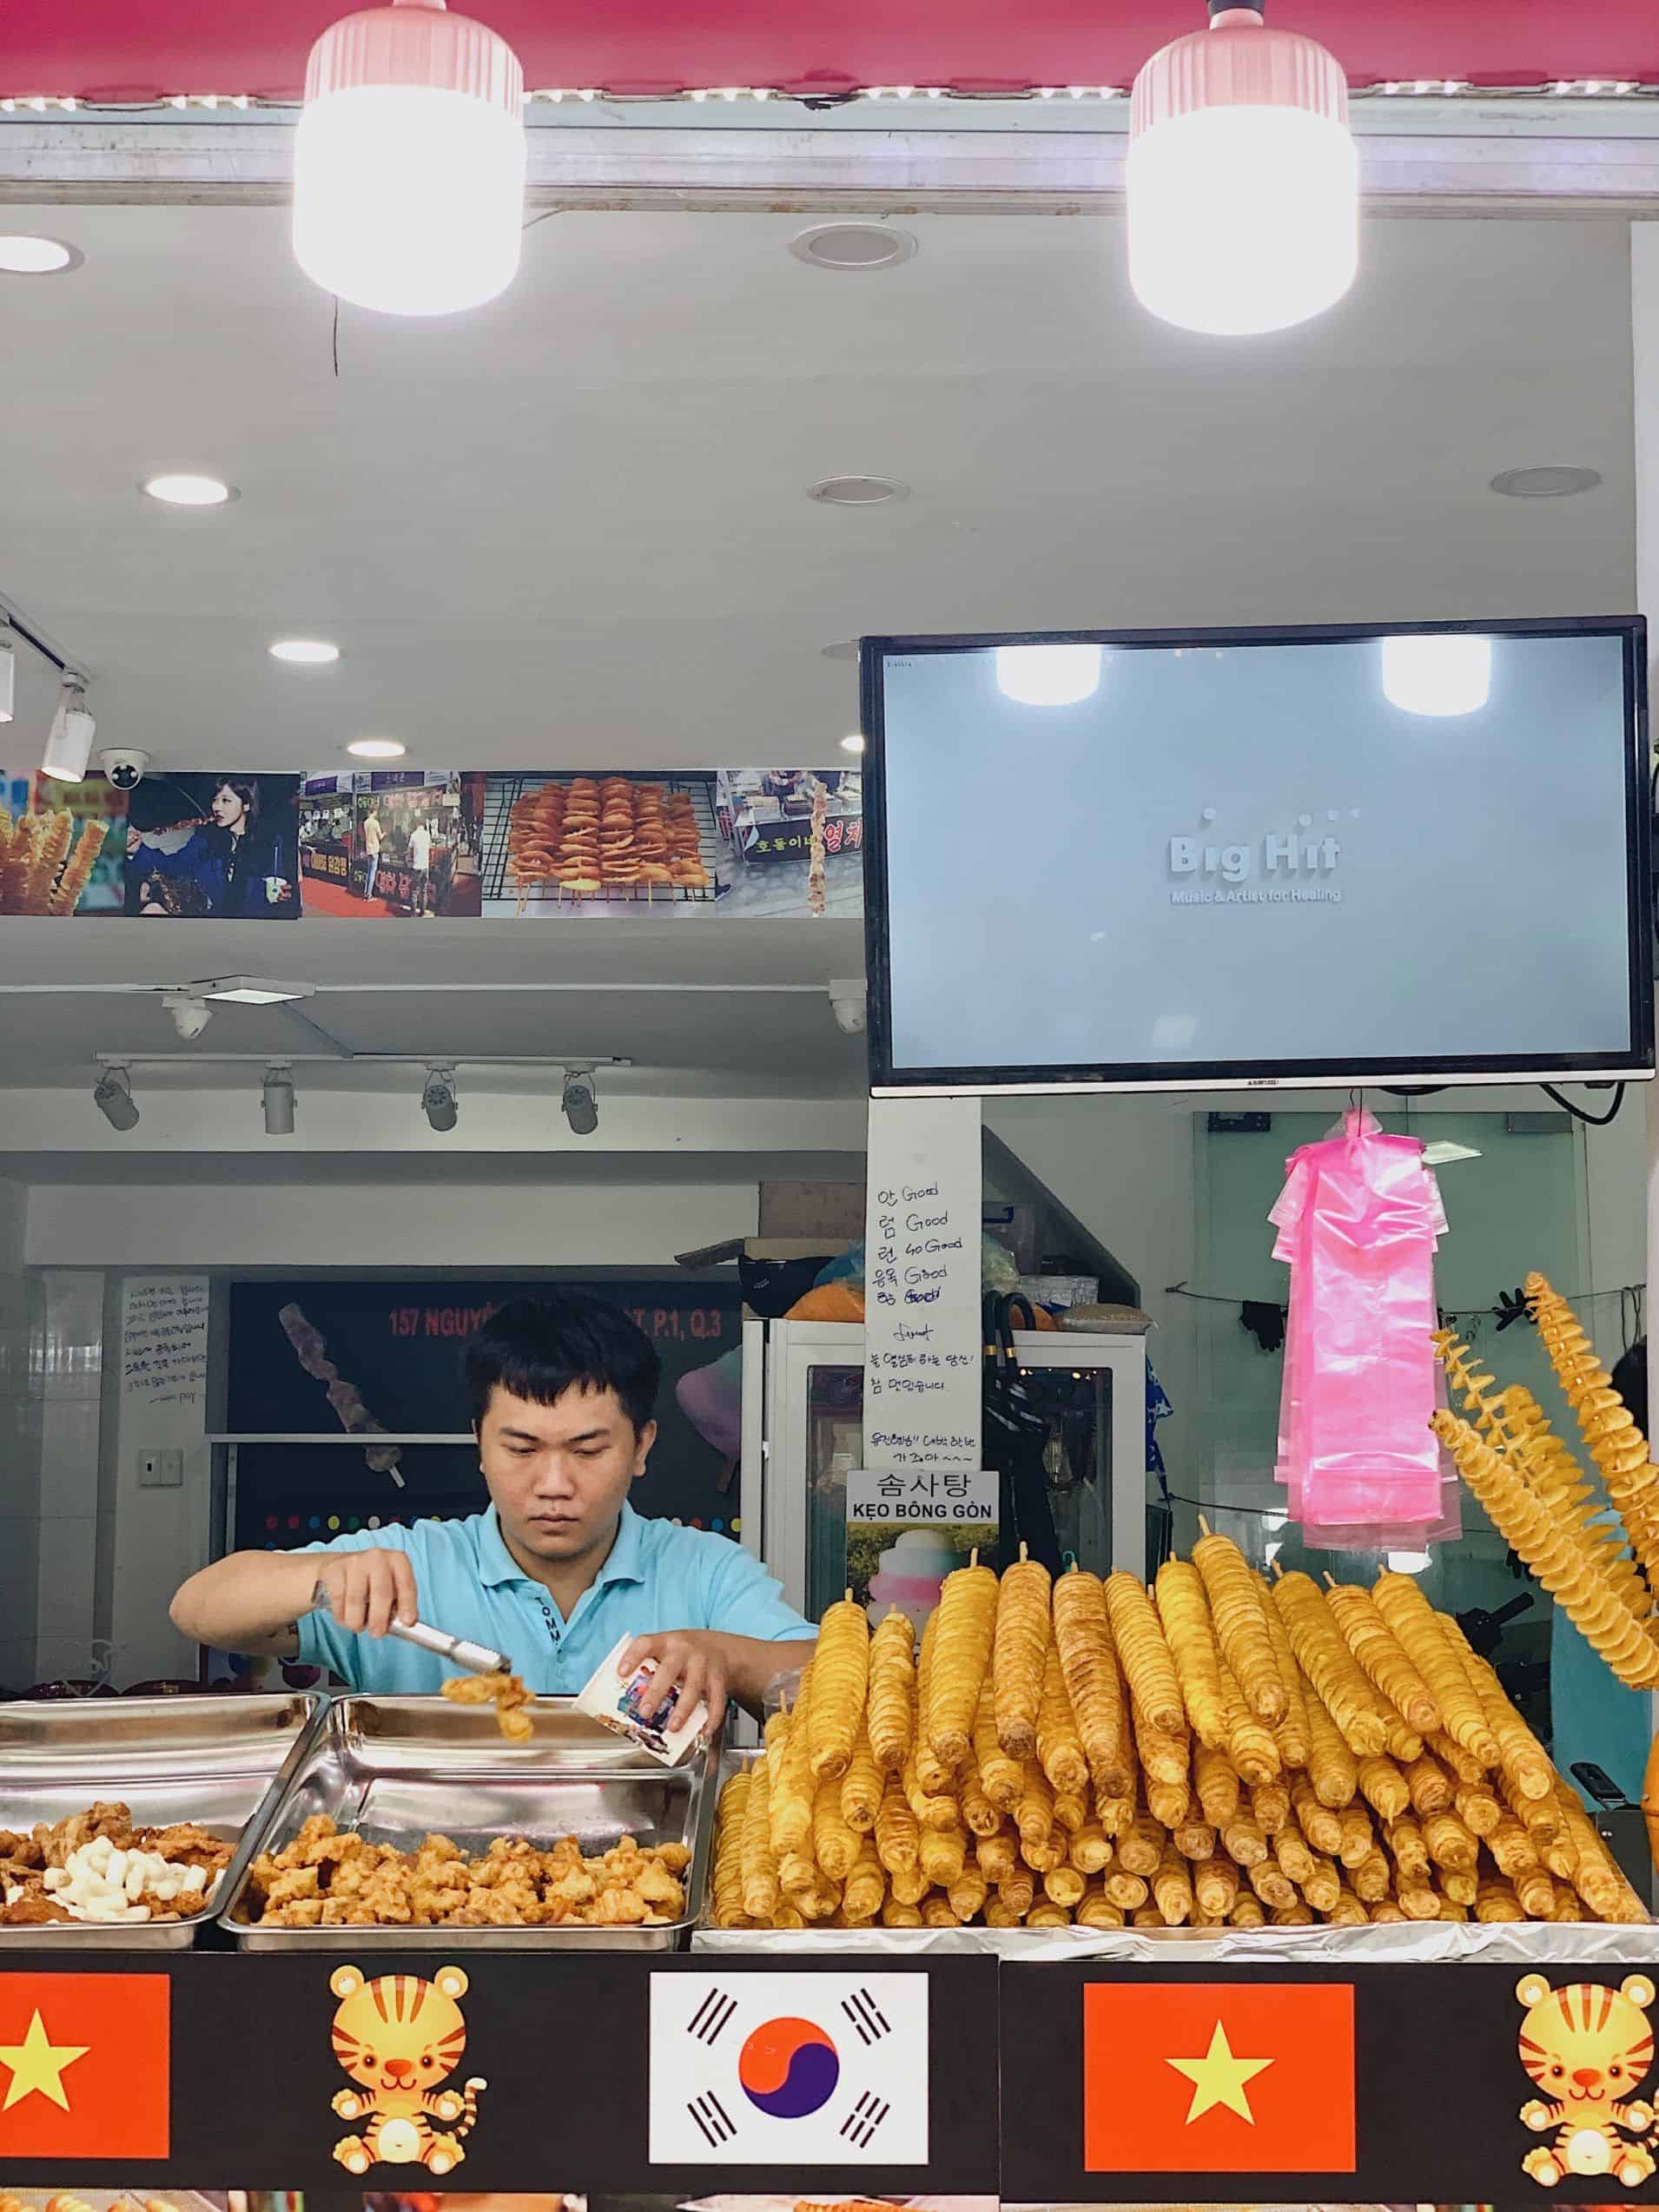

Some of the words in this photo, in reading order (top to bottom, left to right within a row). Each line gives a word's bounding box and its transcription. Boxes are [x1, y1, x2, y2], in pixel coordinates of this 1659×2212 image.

[1169, 808, 1252, 882] Big
[1265, 814, 1342, 871] Hit
[1170, 890, 1212, 904] Music
[1226, 889, 1266, 904] Artist
[1268, 889, 1287, 903] for
[1290, 888, 1342, 903] Healing
[902, 1181, 939, 1202] Good
[906, 1210, 948, 1231] Good
[924, 1238, 962, 1253] Good
[904, 1264, 948, 1284] Good
[389, 1307, 419, 1336] 157
[424, 1301, 494, 1336] NGUY
[876, 1473, 972, 1498] 솜사탕
[853, 1503, 889, 1521] KẸO
[896, 1501, 947, 1518] BÔNG
[953, 1501, 992, 1518] GÒN
[534, 1596, 561, 1646] TOMM
